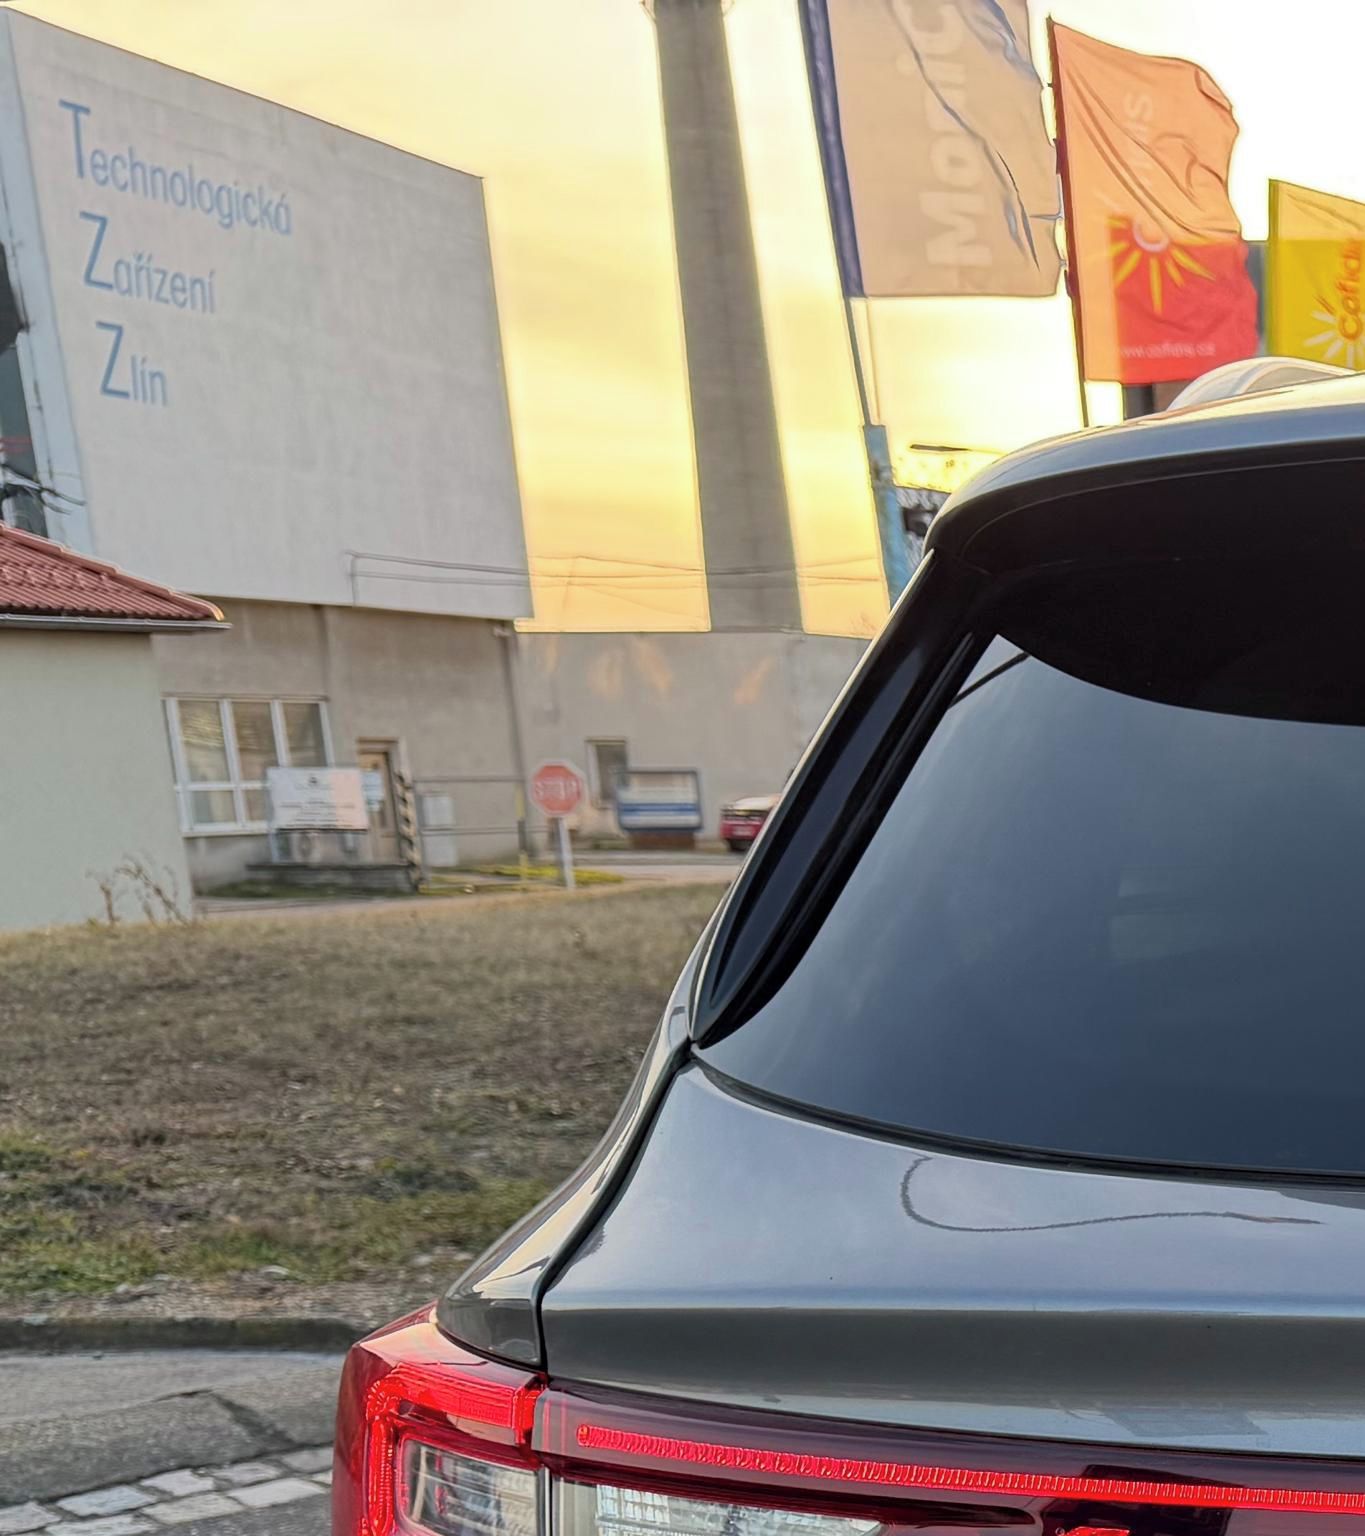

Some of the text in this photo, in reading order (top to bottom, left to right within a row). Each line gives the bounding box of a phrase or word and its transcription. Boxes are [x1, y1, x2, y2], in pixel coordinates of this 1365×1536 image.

[59, 99, 292, 235] Technologická
[79, 211, 216, 315] Zařízení
[96, 320, 168, 407] Zlín
